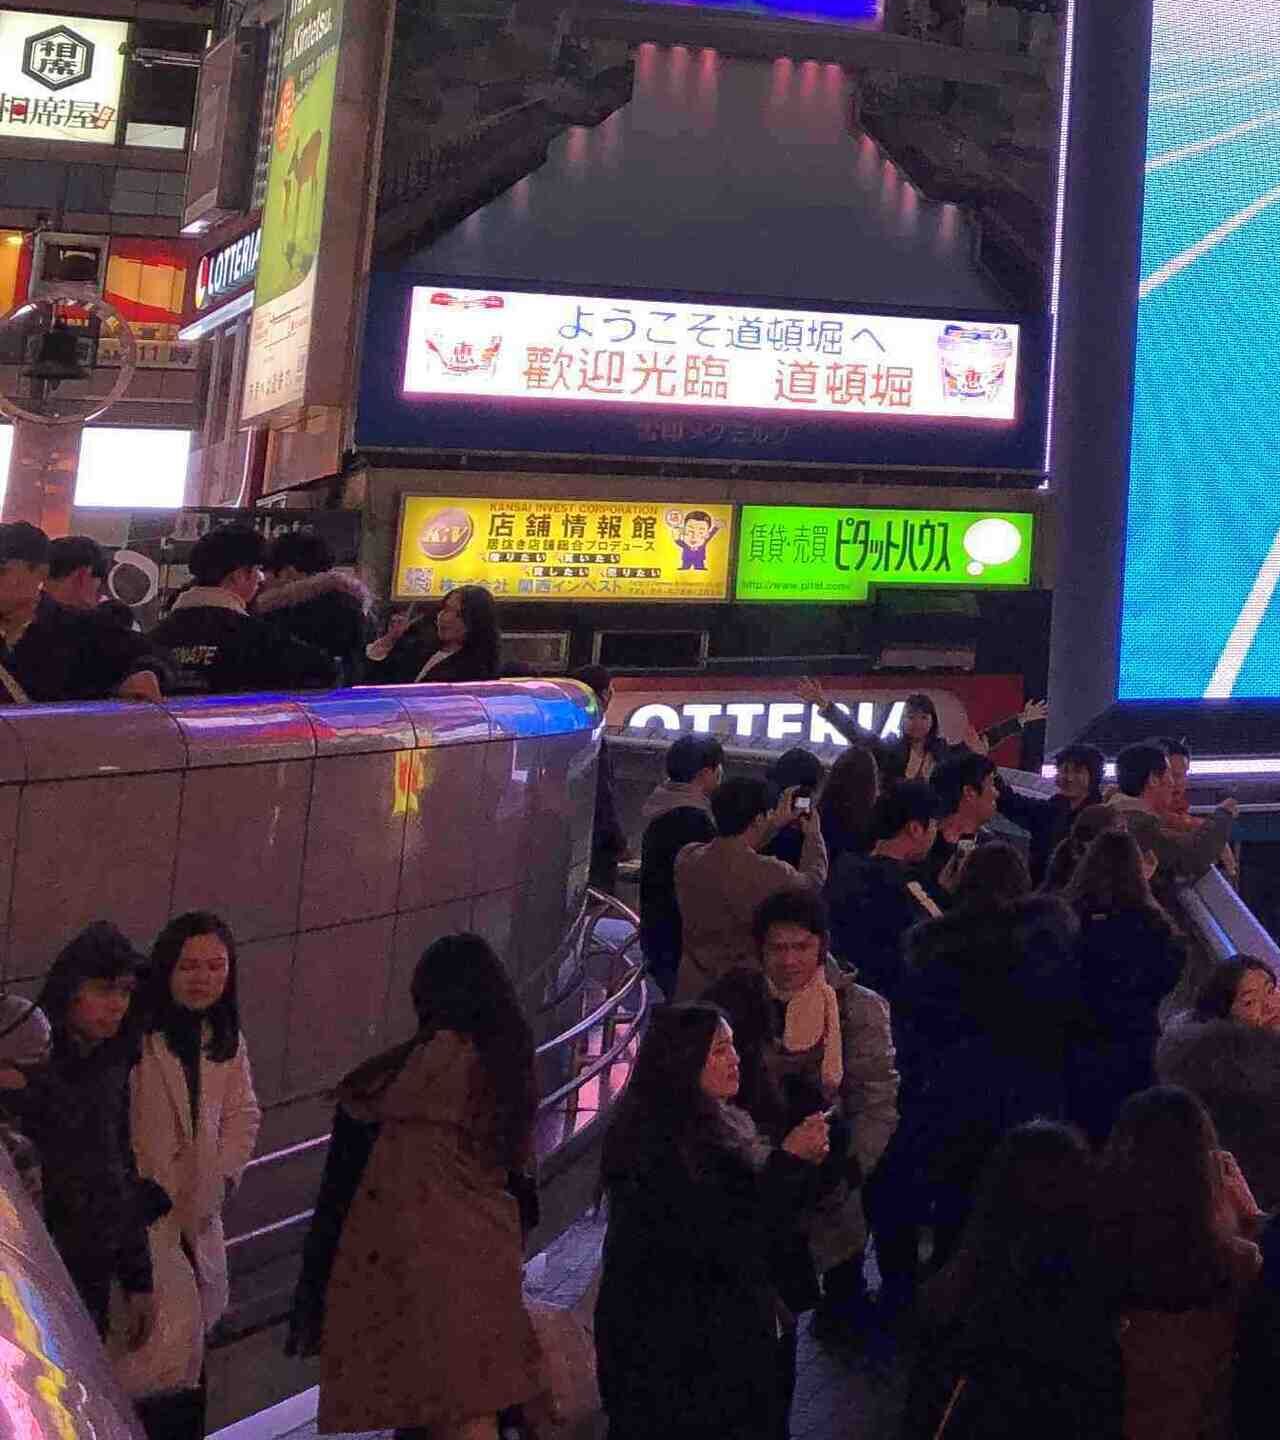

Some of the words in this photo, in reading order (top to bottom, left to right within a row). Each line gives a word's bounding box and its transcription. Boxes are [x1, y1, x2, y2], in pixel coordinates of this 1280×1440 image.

[558, 305, 886, 356] ようこそ道頓堀へ
[773, 360, 914, 408] 道頓堀
[487, 538, 656, 552] 居抜き店舗総合プロデュース
[488, 512, 657, 541] 店舗情報館
[834, 517, 951, 573] ピタットハウス
